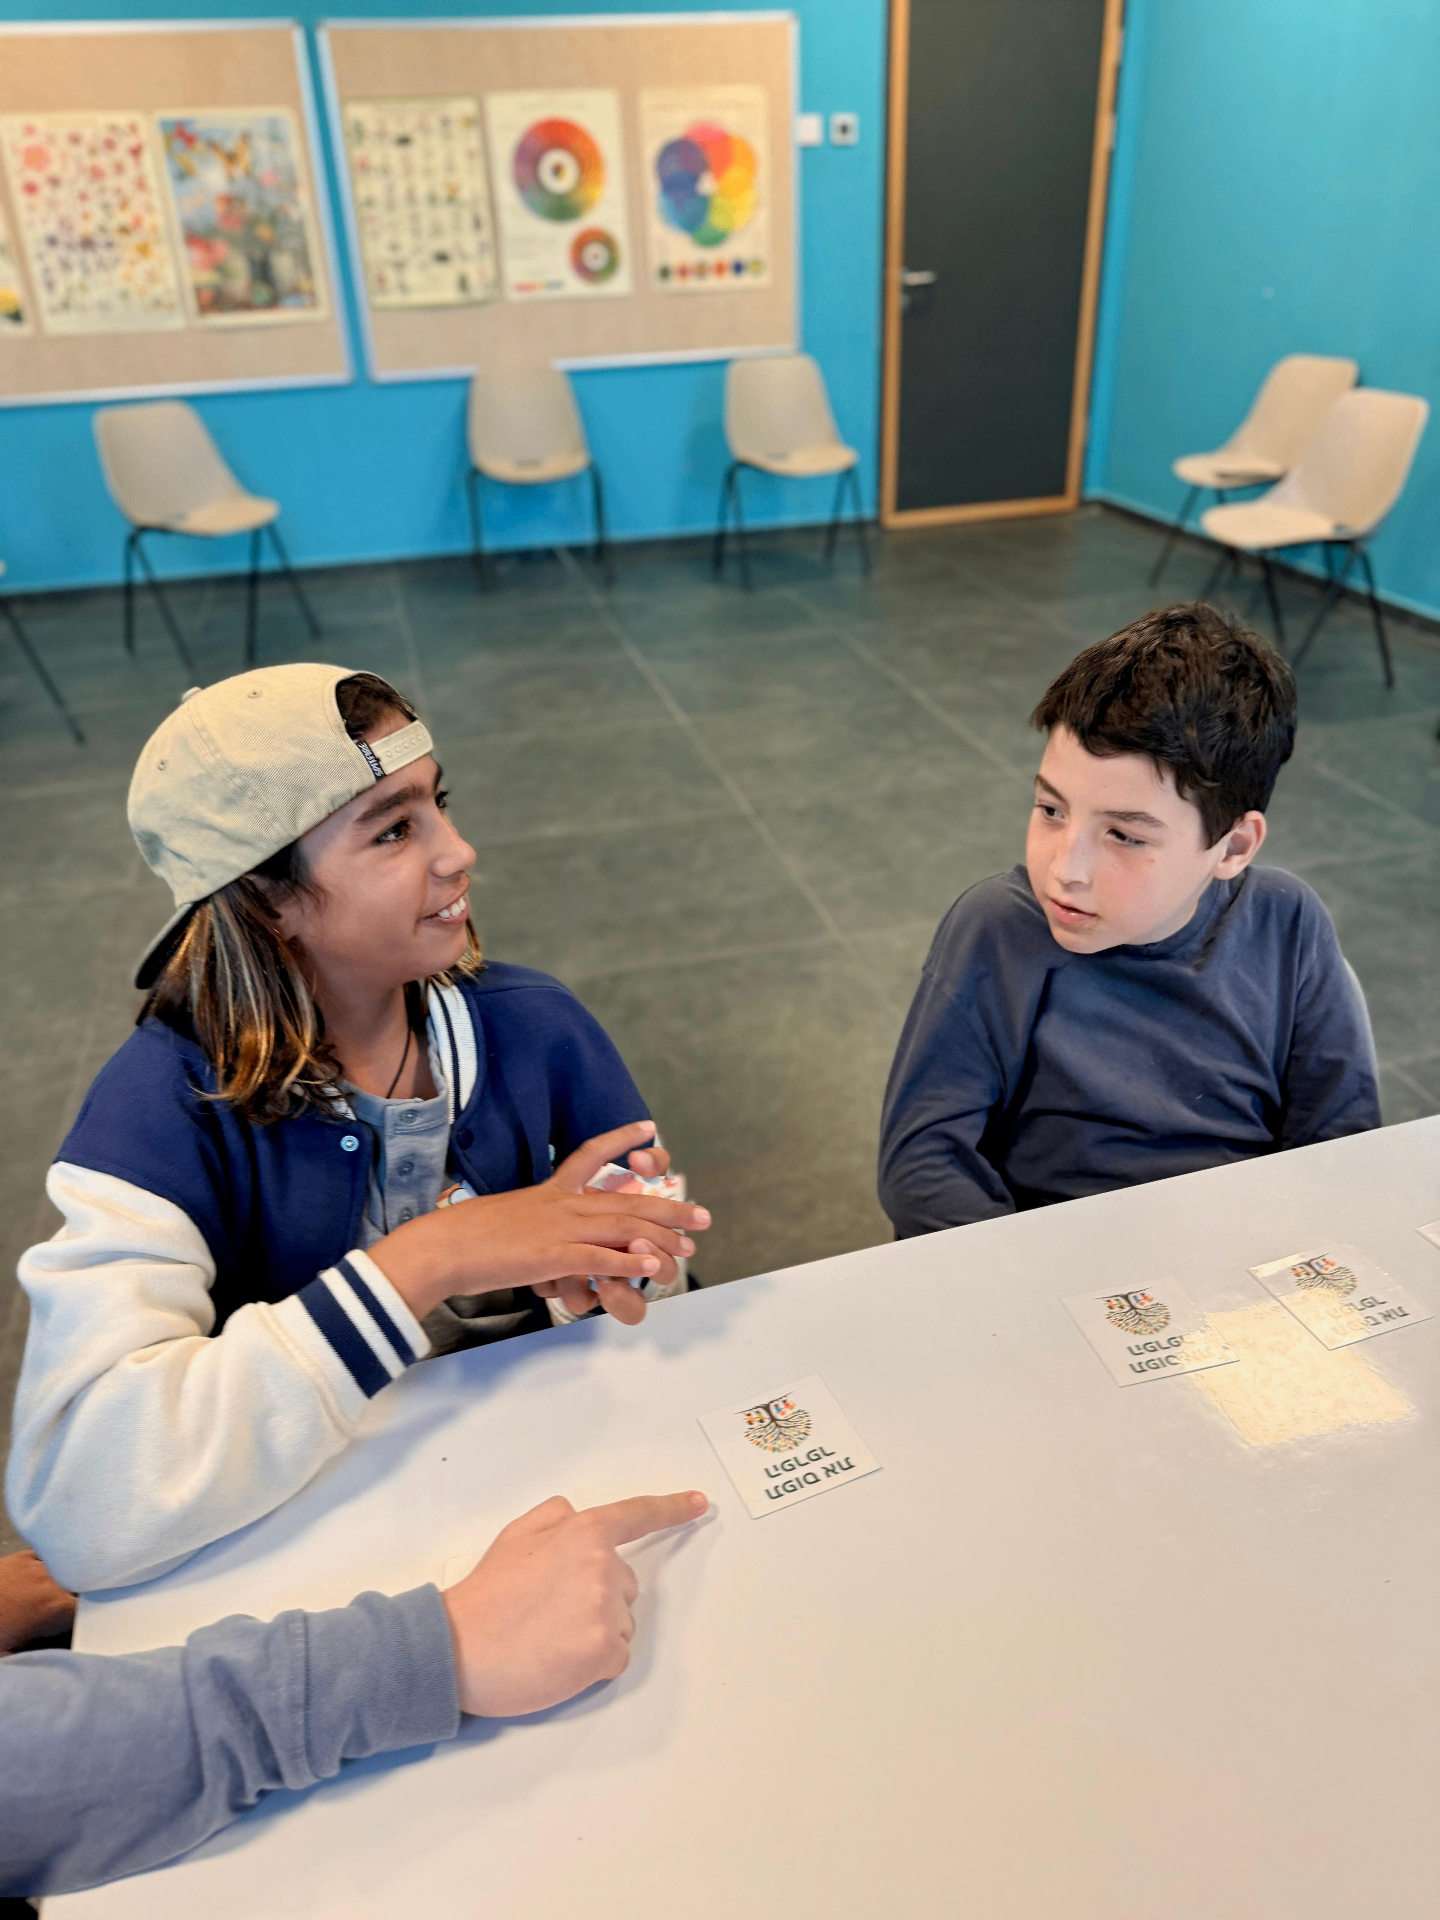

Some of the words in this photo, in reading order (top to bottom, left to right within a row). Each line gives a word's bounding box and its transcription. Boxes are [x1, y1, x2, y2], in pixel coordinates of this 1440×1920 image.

[763, 1445, 836, 1479] הפרפר
[764, 1471, 822, 1500] תפוס
[821, 1456, 856, 1478] את
